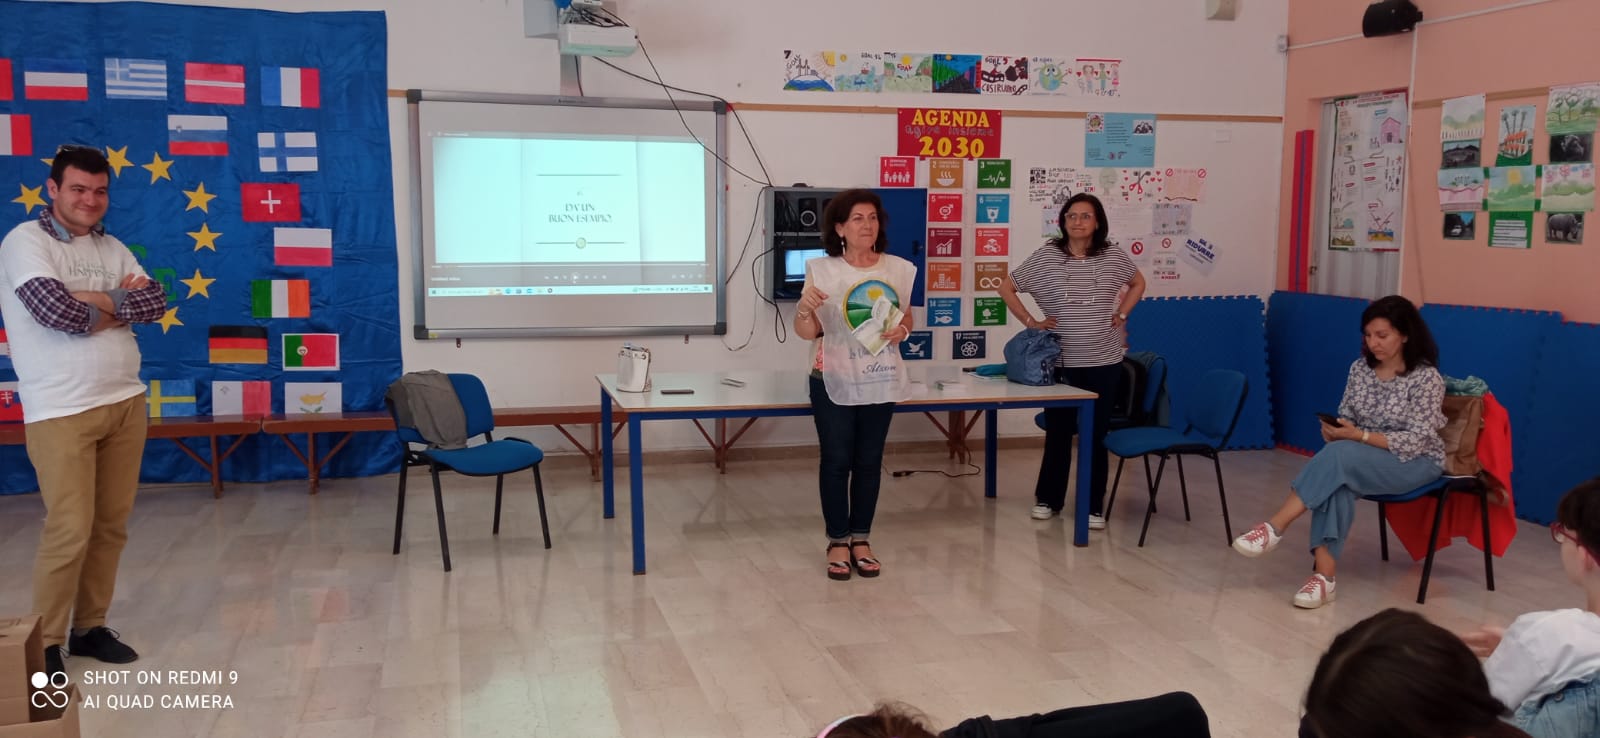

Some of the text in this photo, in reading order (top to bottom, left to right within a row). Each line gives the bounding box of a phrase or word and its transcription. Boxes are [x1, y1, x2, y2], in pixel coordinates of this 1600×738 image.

[783, 49, 792, 60] 7
[911, 109, 990, 128] AGENDA
[919, 136, 985, 158] 2030
